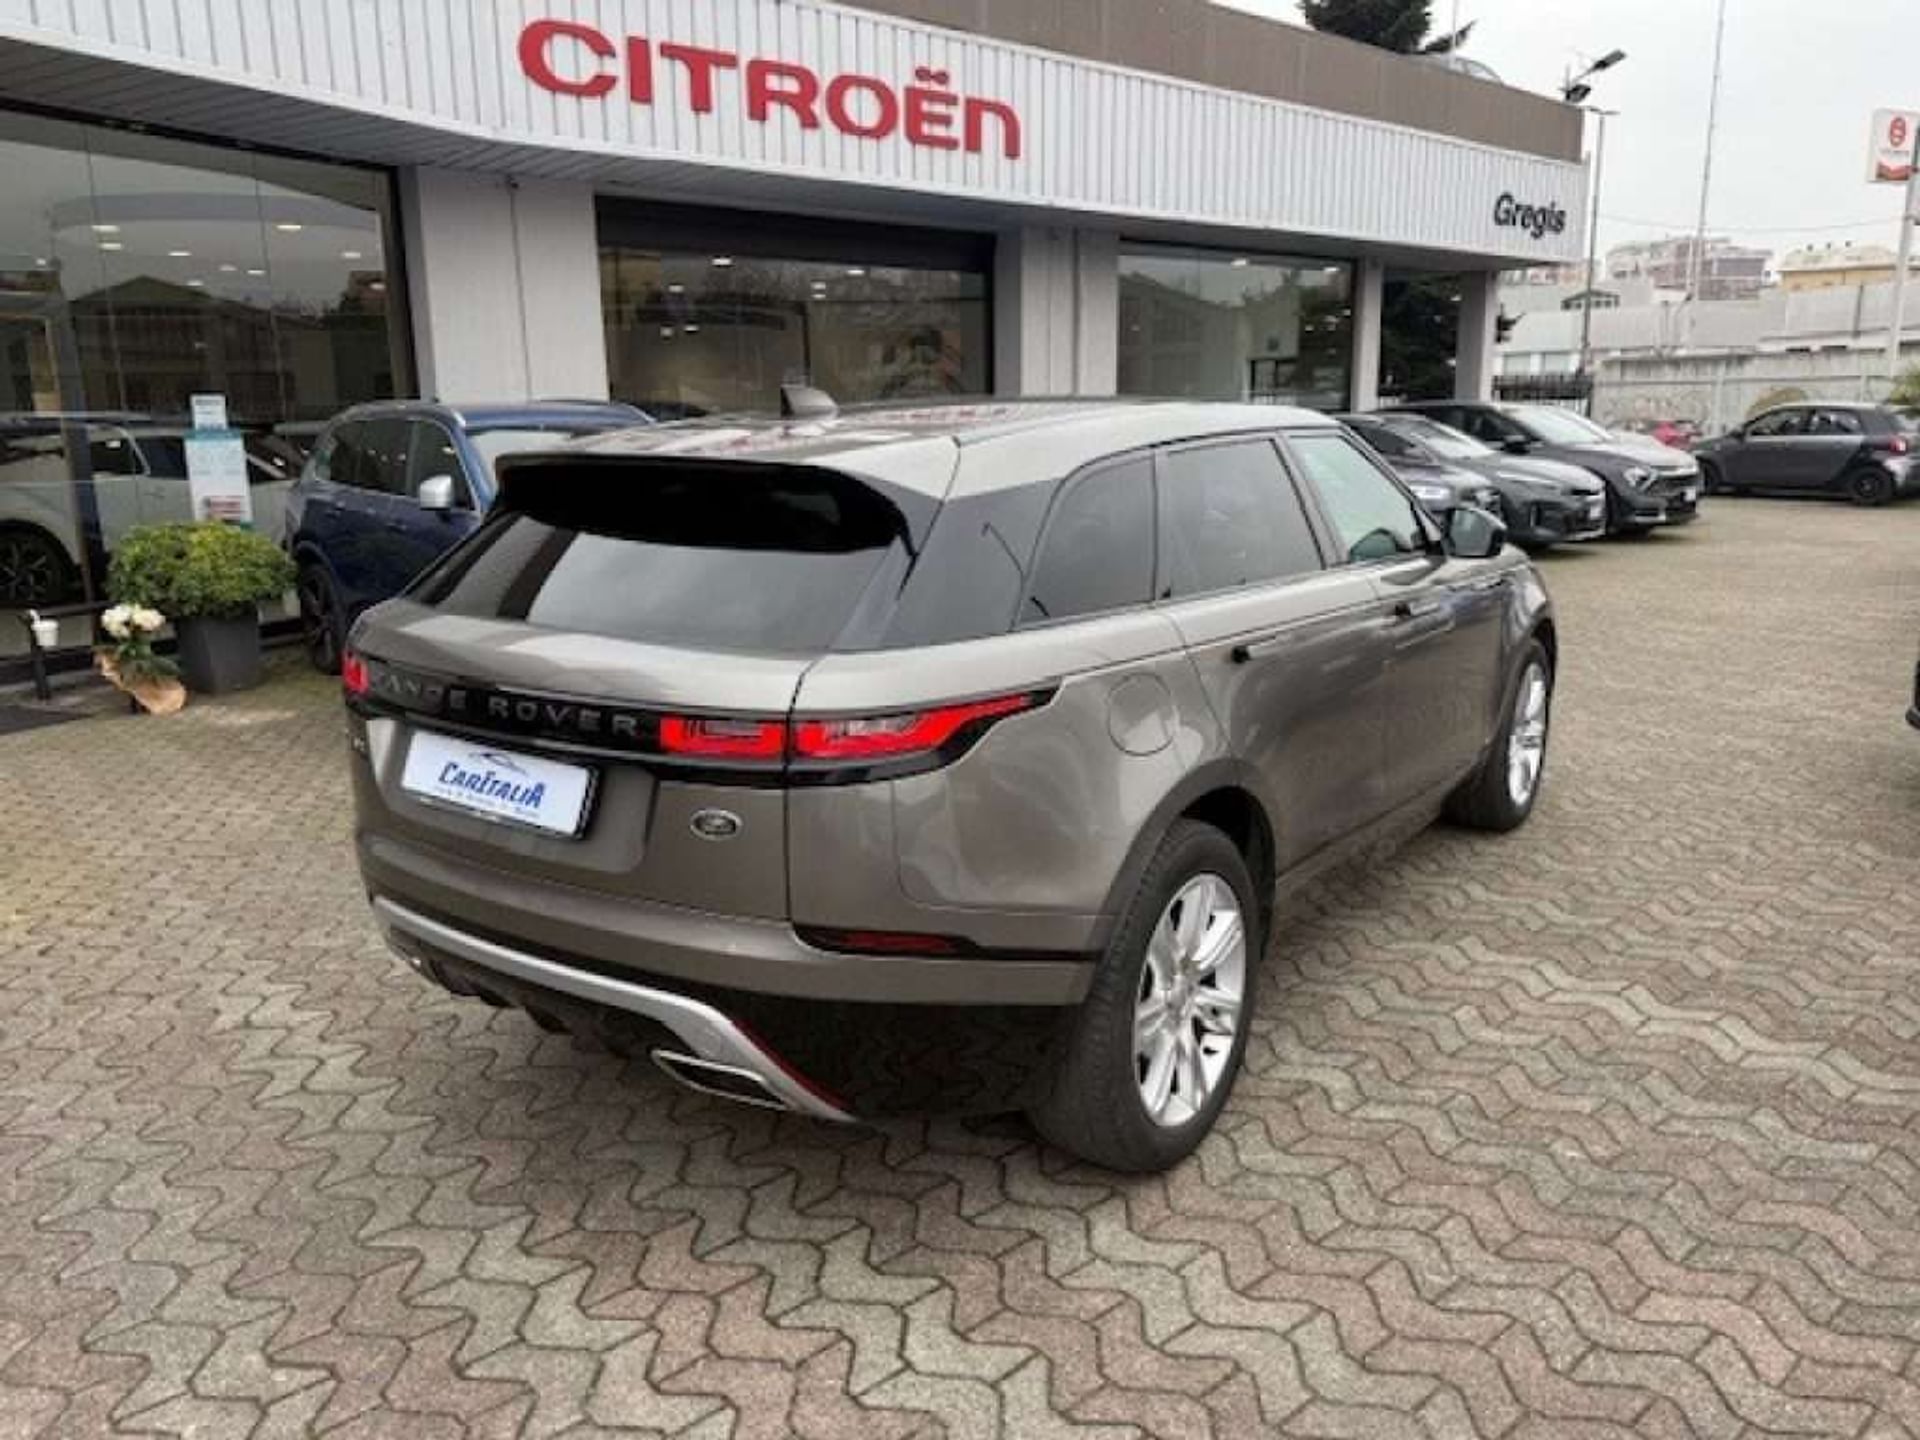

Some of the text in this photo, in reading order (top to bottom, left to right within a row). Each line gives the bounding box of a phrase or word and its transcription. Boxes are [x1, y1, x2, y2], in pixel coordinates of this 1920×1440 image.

[1493, 191, 1566, 240] Gregis
[370, 666, 639, 737] ANE ROVER
